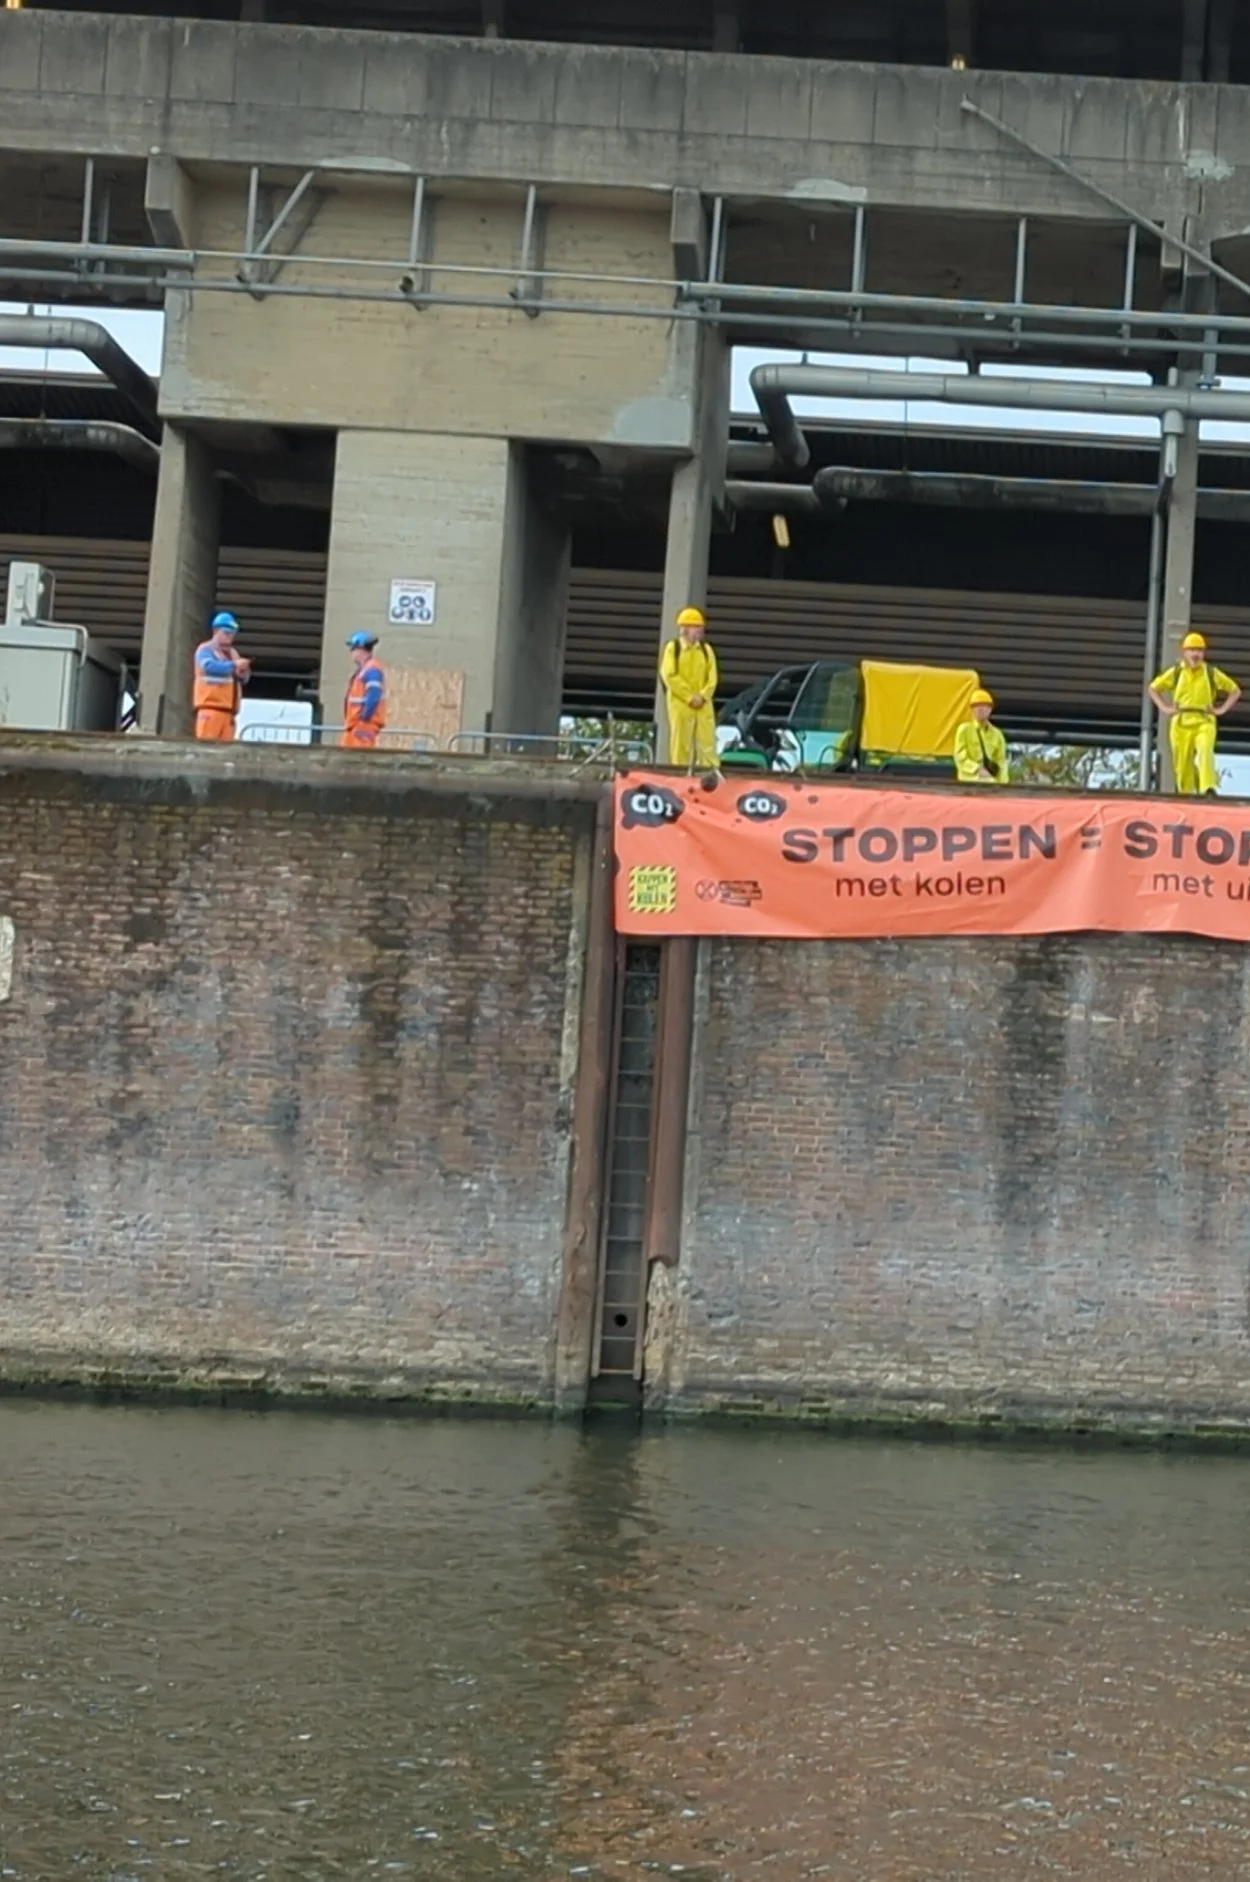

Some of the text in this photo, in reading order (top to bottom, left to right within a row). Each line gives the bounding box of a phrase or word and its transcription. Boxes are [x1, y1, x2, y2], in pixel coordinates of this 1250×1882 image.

[781, 824, 1057, 864] STOPPEN
[835, 871, 1006, 897] met kolen
[1153, 873, 1214, 897] met
